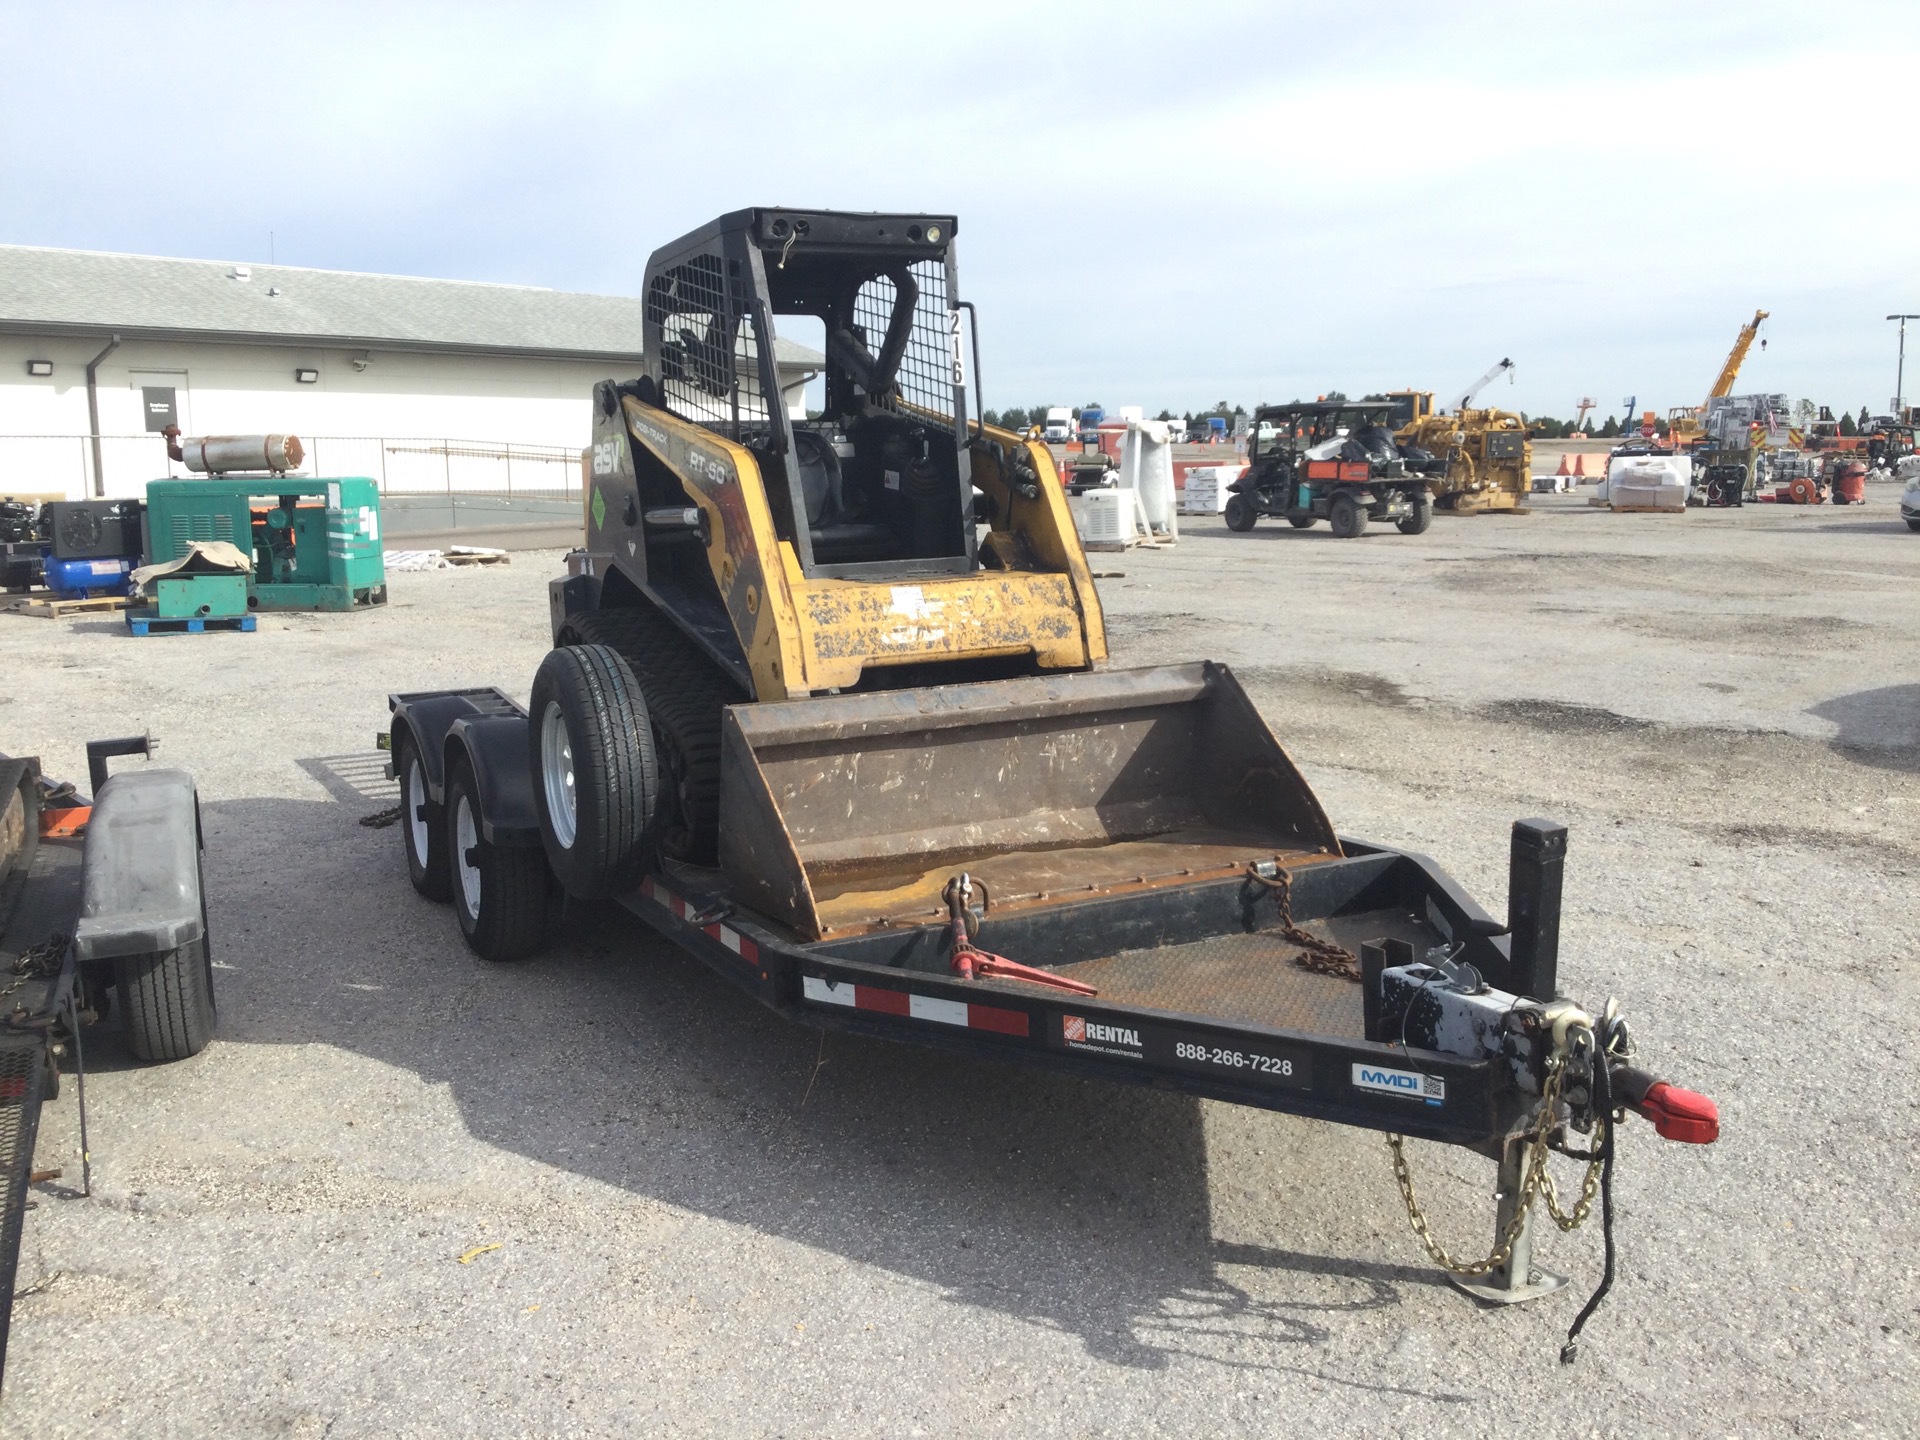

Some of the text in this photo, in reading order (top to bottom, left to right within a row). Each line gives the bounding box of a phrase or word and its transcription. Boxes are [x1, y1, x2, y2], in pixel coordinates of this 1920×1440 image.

[950, 314, 962, 384] 216
[636, 420, 668, 445] POSI-TRACK
[1086, 1022, 1143, 1047] RENTAL
[1069, 1041, 1144, 1059] homedepot.com/rentals
[1176, 1042, 1293, 1076] 888-266-7228
